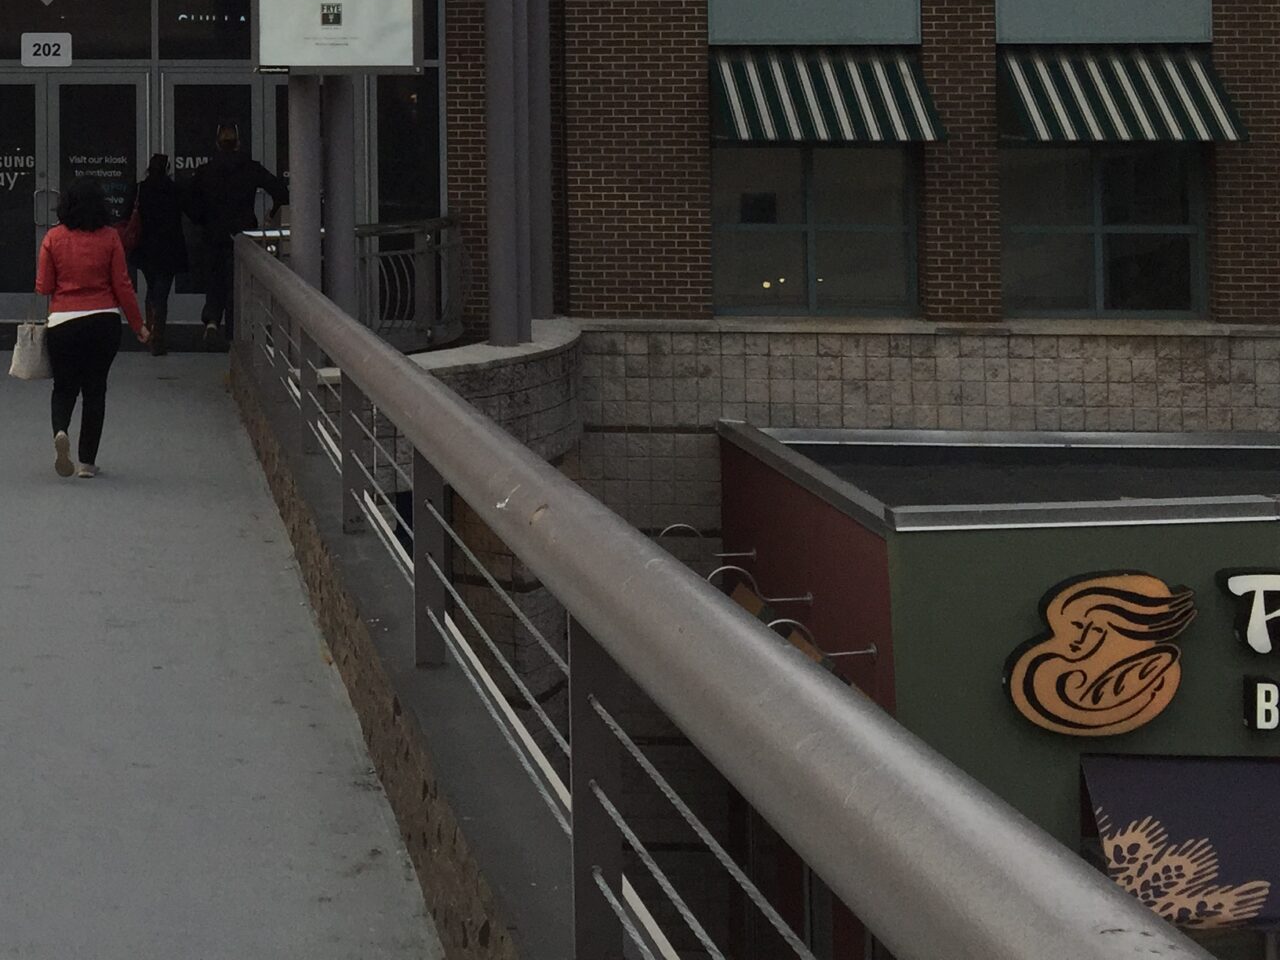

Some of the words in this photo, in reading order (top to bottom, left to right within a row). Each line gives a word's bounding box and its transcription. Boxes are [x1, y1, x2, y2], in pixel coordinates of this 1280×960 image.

[321, 4, 342, 13] FRYE
[32, 43, 61, 57] 202
[1256, 682, 1280, 730] B
